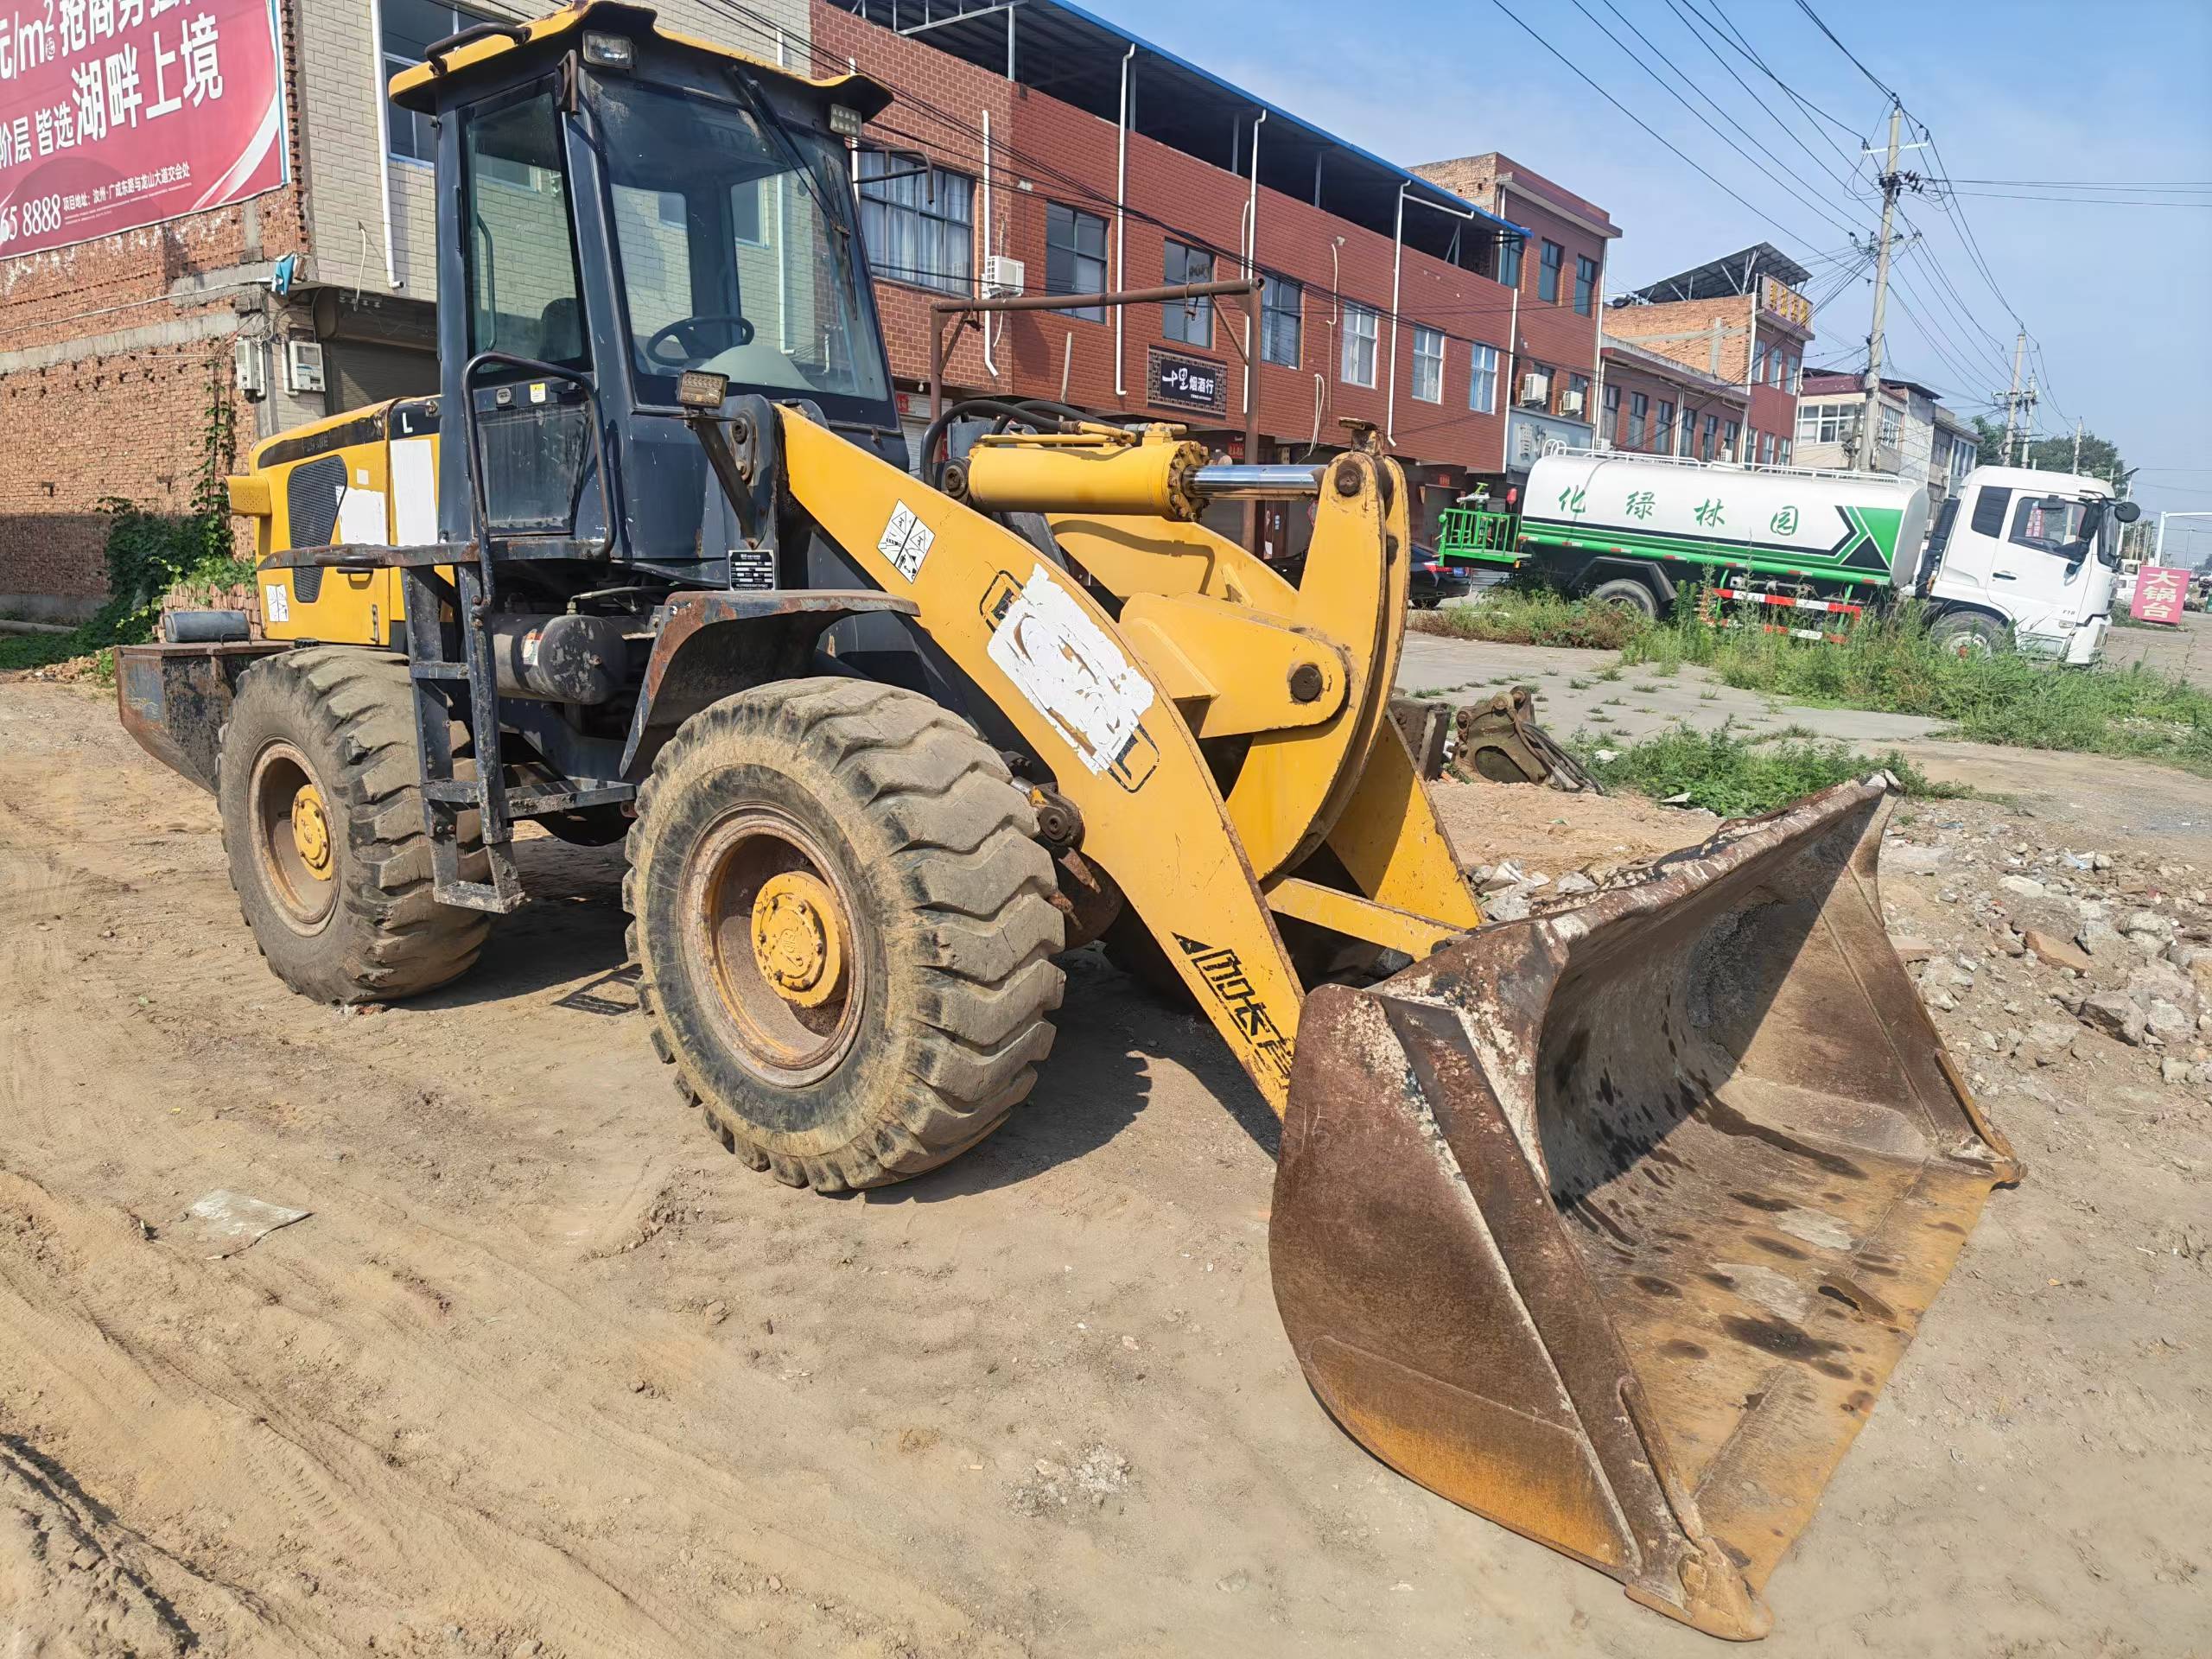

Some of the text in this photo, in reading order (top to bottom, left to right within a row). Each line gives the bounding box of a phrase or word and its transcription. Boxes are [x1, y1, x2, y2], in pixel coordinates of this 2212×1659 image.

[72, 12, 223, 146] 湖畔上境
[22, 194, 60, 238] 8888
[2143, 570, 2181, 619] 大锅台
